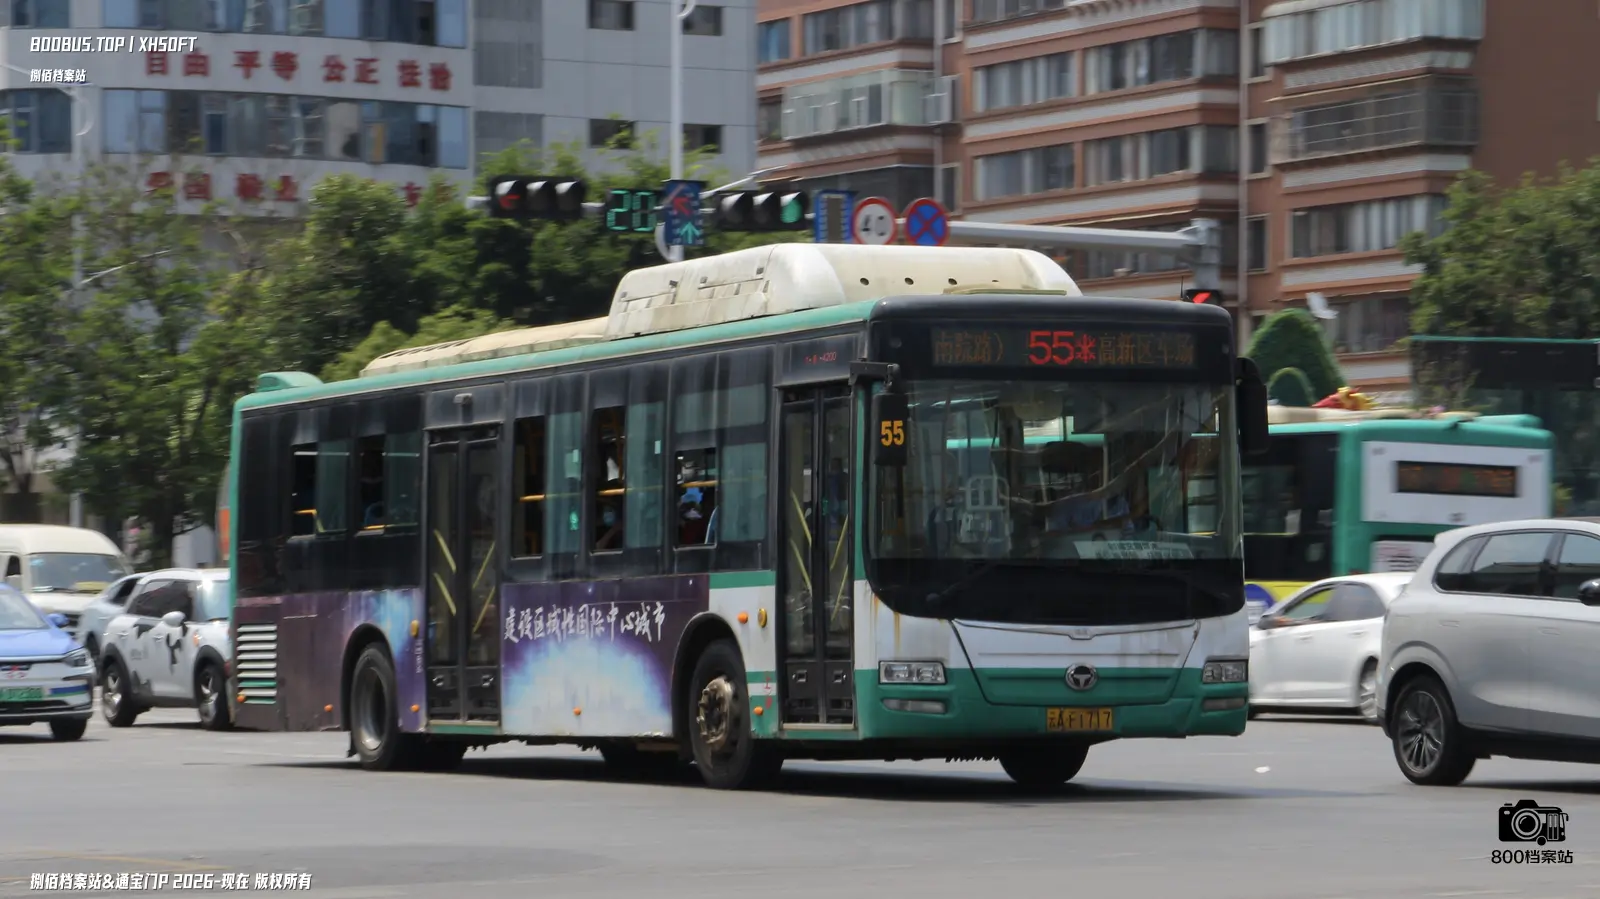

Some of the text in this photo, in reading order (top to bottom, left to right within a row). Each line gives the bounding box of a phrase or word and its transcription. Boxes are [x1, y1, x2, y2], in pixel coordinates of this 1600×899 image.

[146, 48, 210, 77] 自由
[233, 50, 299, 81] 平等
[321, 54, 380, 84] 公正
[606, 189, 657, 232] 20
[1028, 330, 1075, 365] 55
[880, 420, 905, 446] 55
[503, 600, 667, 643] 建设区域性国际中心城市
